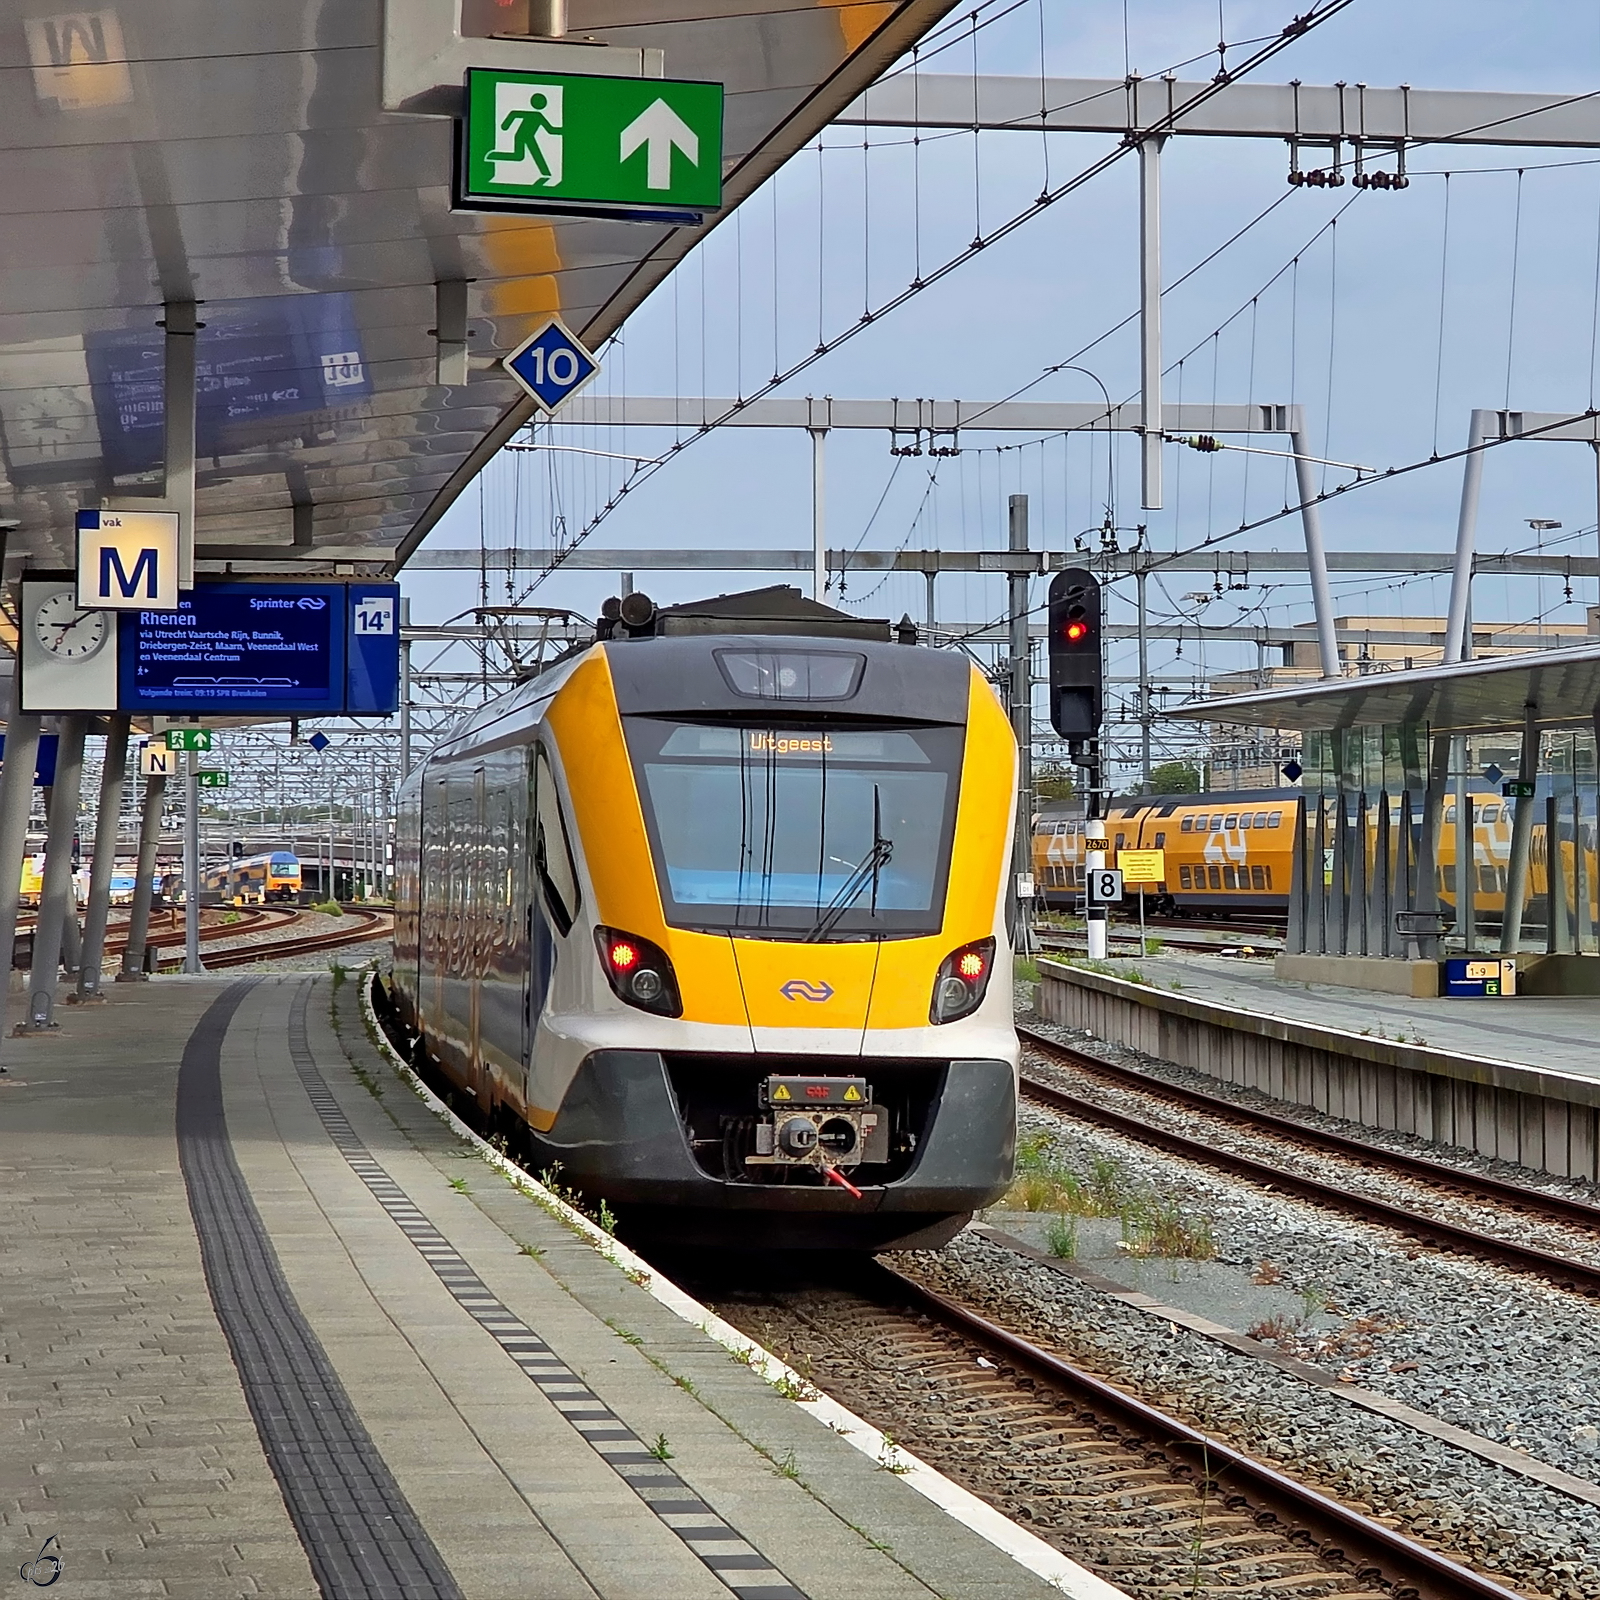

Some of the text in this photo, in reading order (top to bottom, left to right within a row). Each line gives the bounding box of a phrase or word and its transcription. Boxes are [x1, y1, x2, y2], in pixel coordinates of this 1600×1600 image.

[530, 346, 579, 387] 10
[102, 517, 122, 527] vak
[98, 546, 158, 599] M
[249, 598, 295, 610] Sprinter
[140, 612, 197, 626] Rhenen
[357, 610, 391, 631] 14a
[139, 630, 284, 641] via Utrecht Vaartsche Rijn, Bunnik,
[139, 641, 319, 652] Driebergen-Zeist, Maarn, Veenendaal West
[139, 652, 240, 662] en Veenendaal Centrum
[139, 689, 173, 697] Volgende
[174, 689, 193, 697] trein:
[750, 733, 833, 753] Uitgeest
[150, 753, 167, 772] N
[1086, 840, 1108, 849] 2670
[1100, 873, 1115, 898] 8
[1469, 967, 1486, 976] 1-9
